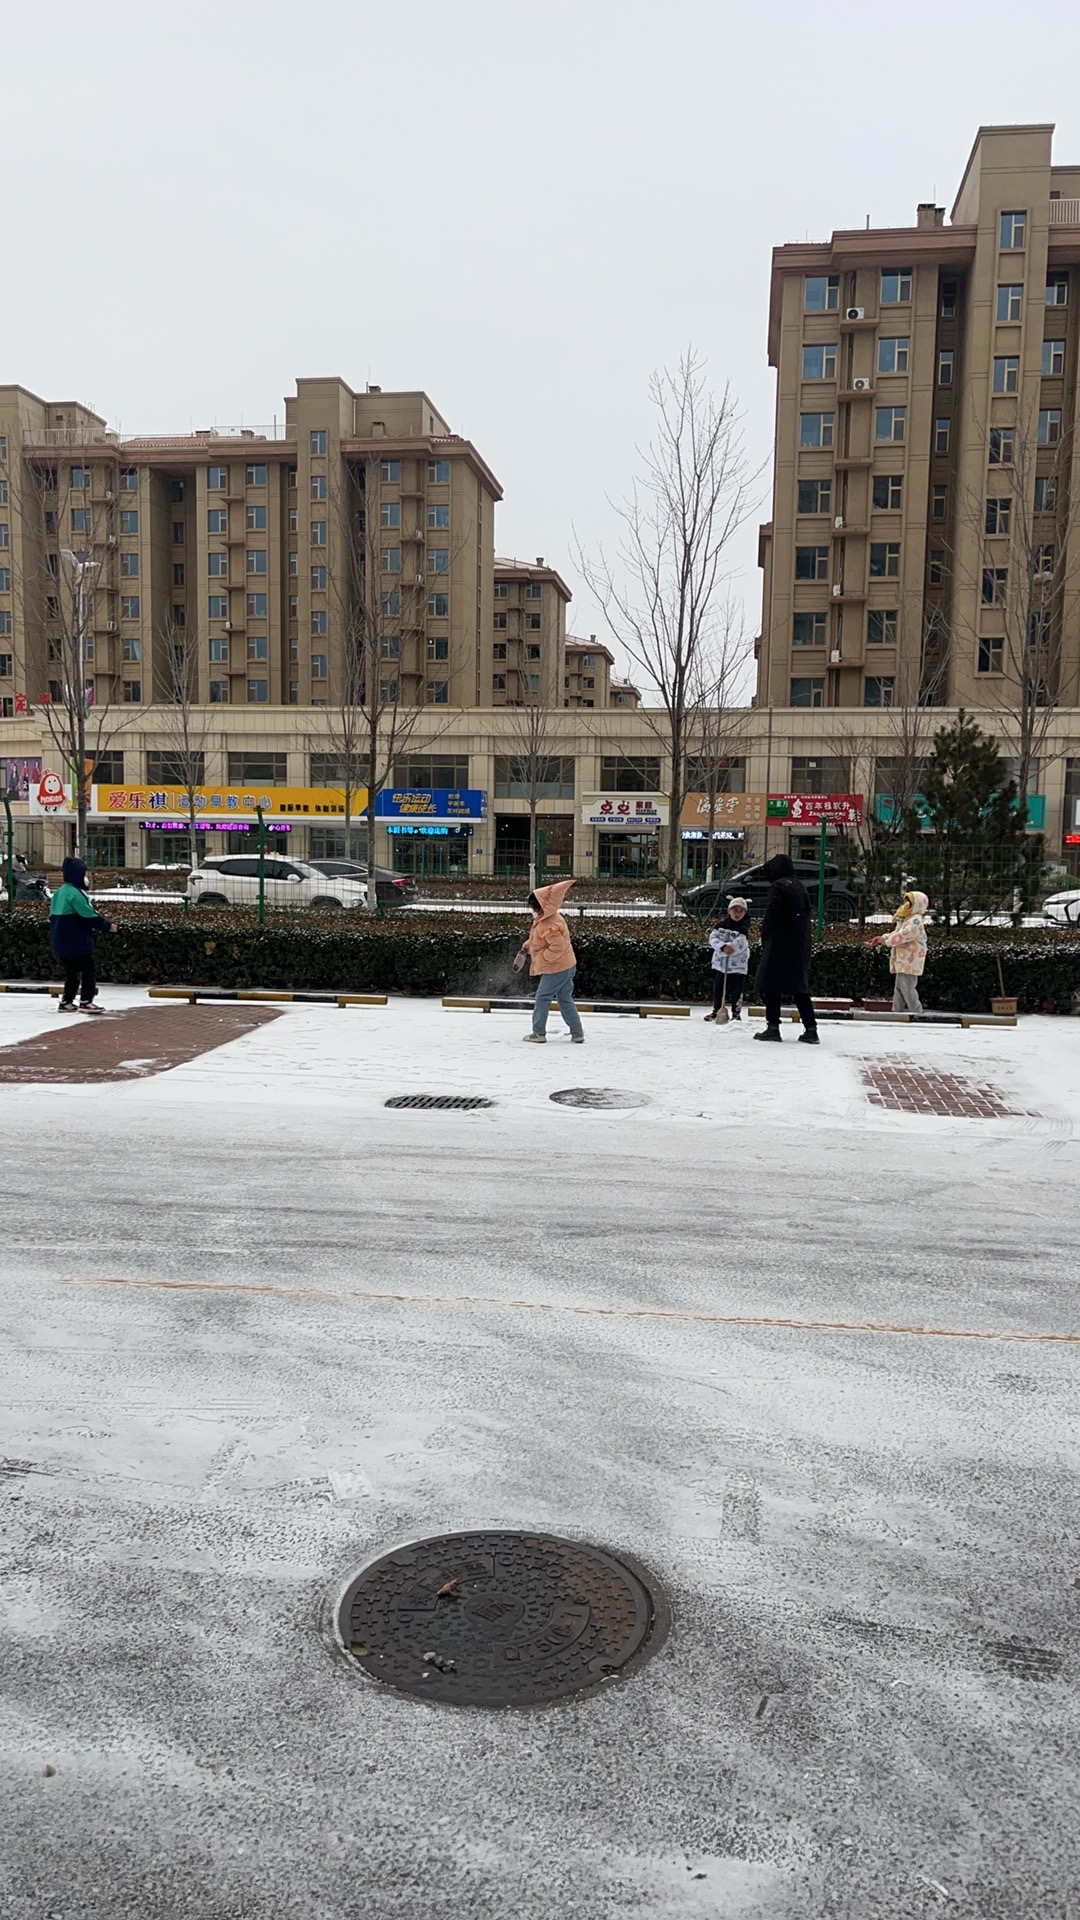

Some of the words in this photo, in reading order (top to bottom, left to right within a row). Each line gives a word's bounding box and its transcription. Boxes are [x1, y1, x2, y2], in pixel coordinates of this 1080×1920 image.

[109, 791, 168, 811] 爱乐祺
[178, 793, 273, 811] 运动早教中心
[392, 793, 432, 804] 快乐运动
[399, 803, 437, 813] 健康成长
